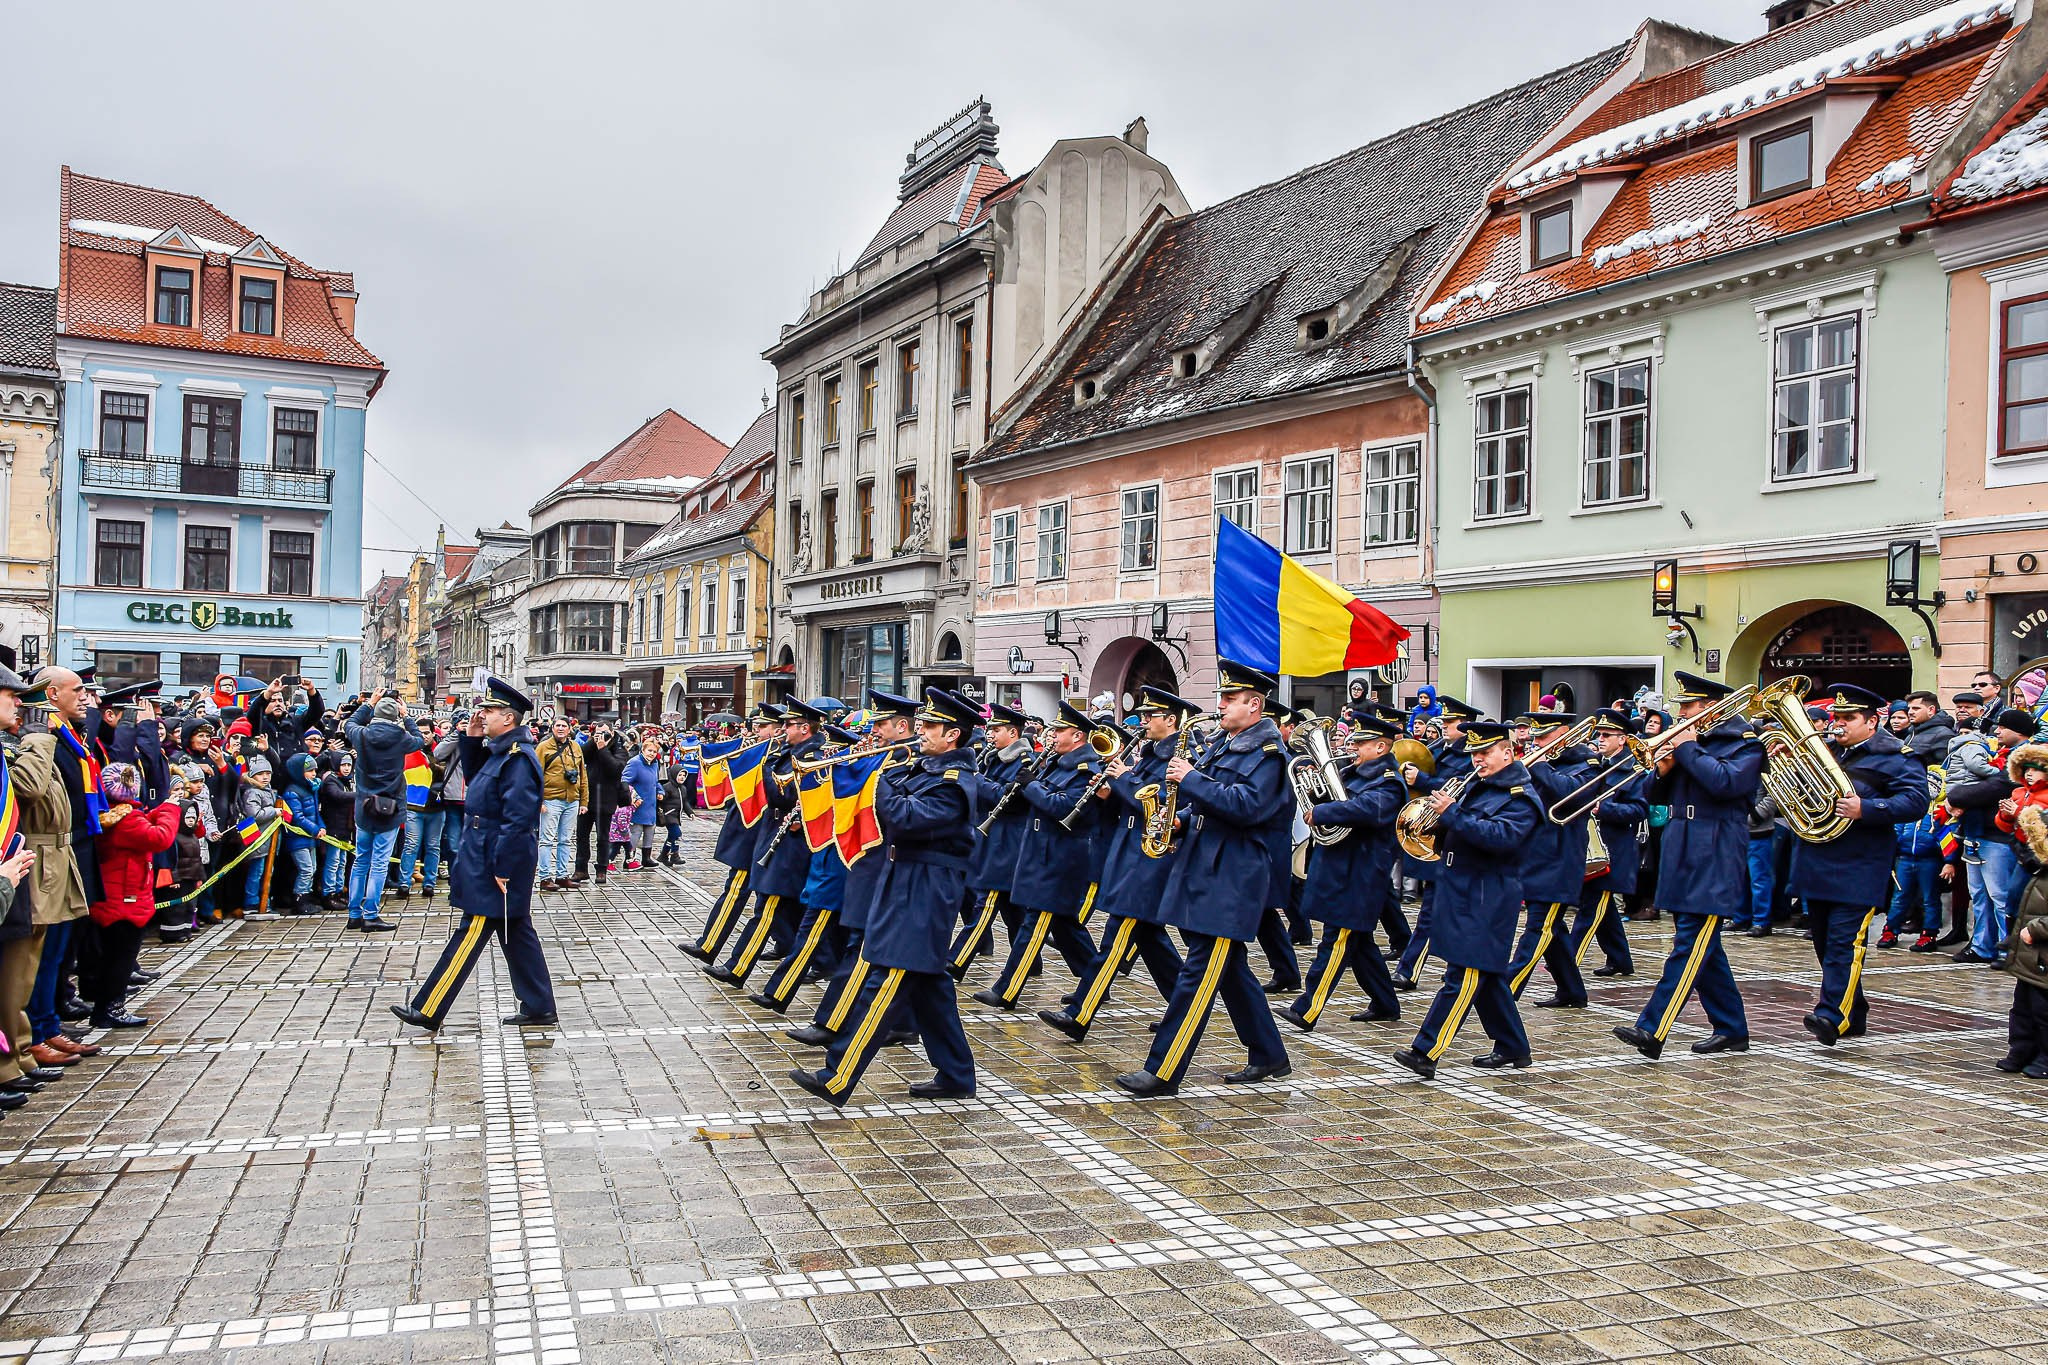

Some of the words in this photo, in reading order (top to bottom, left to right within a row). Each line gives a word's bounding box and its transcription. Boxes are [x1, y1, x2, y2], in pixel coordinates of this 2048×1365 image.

[820, 576, 883, 600] BRASSERIE
[126, 602, 184, 623] CEC
[223, 606, 294, 628] Bank
[2011, 609, 2048, 639] LOTO
[562, 682, 606, 693] vodafone
